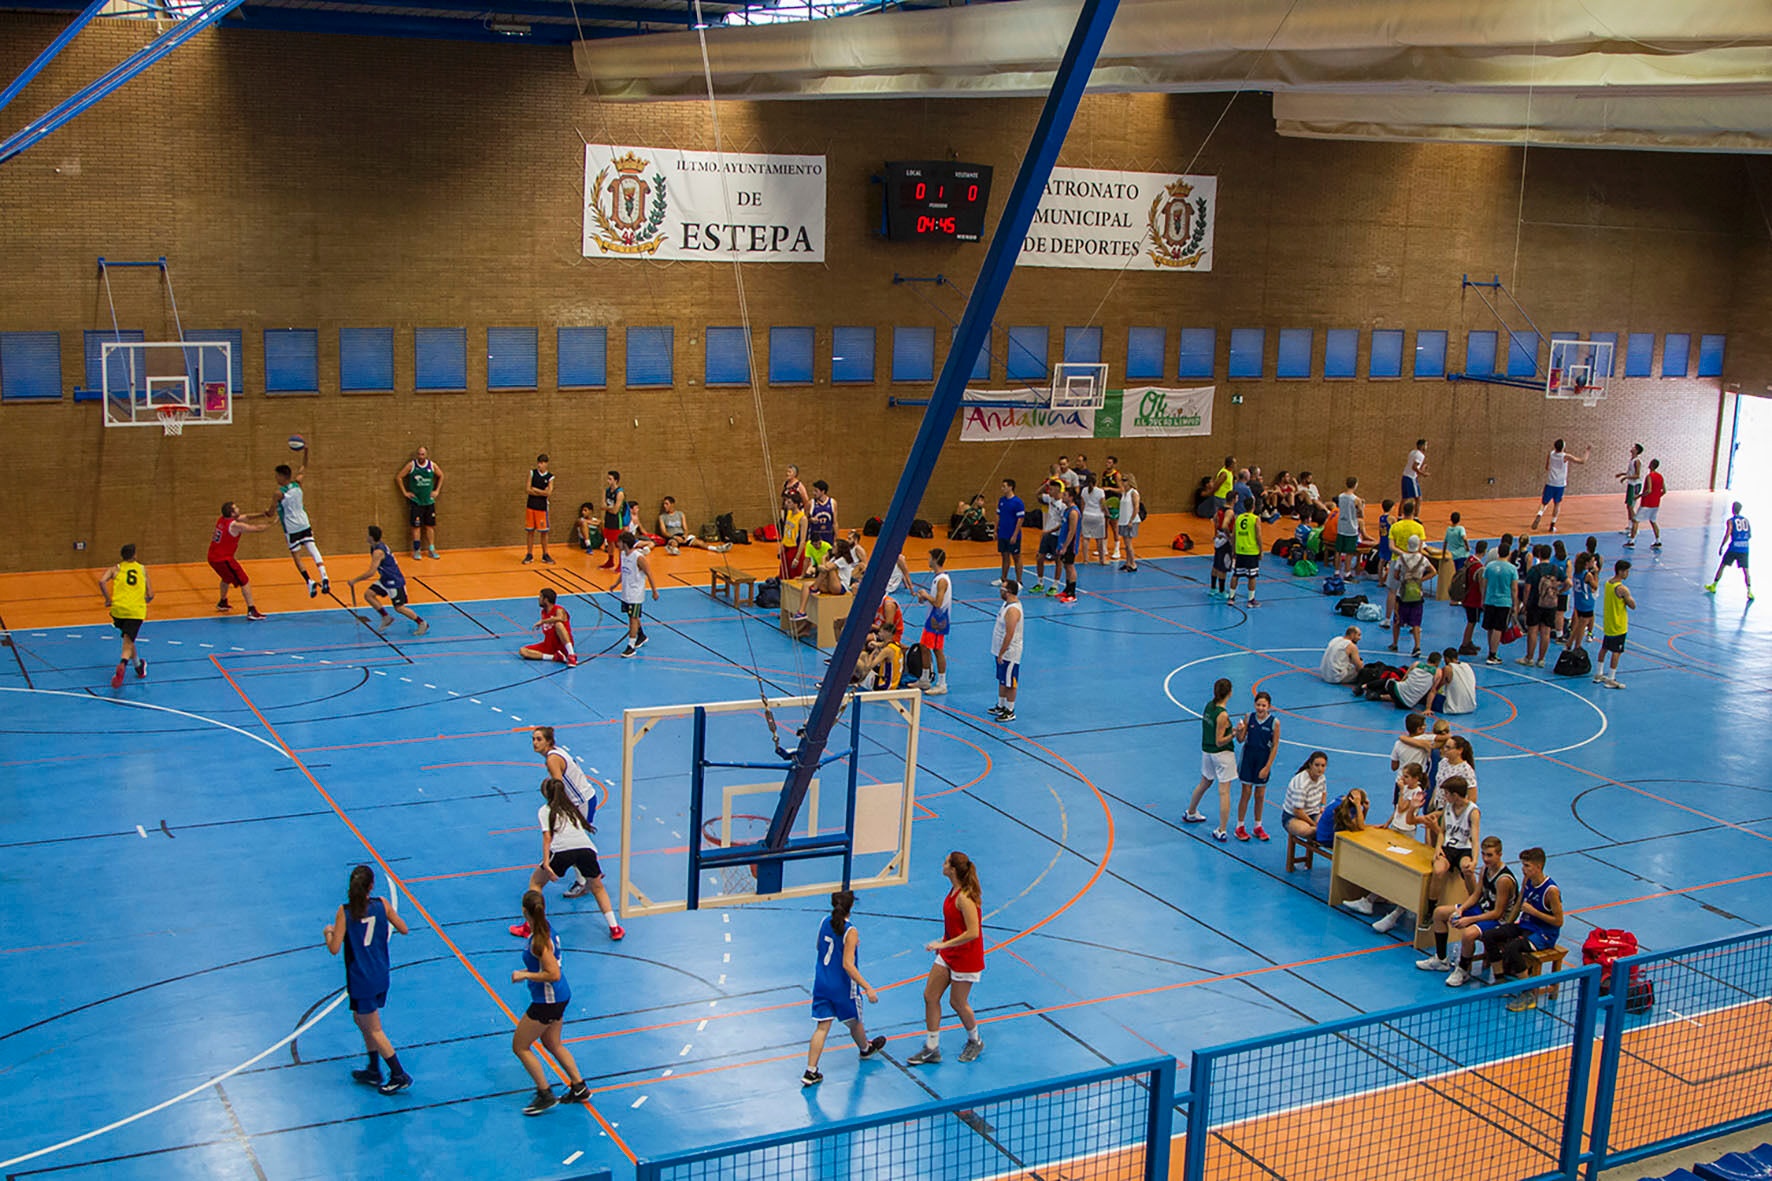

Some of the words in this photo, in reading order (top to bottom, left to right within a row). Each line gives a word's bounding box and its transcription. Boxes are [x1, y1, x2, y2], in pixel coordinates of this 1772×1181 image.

[677, 160, 720, 172] ILTMO.
[722, 163, 822, 175] AYUNTAMIENTO
[906, 169, 922, 177] LOCAL
[737, 191, 762, 206] DE
[915, 182, 926, 200] 0
[939, 185, 944, 198] 1
[967, 184, 979, 202] 0
[1044, 180, 1139, 200] ATRONATO
[917, 215, 956, 234] 04:45
[1033, 208, 1132, 227] MUNICIPAL
[680, 222, 815, 252] ESTEPA
[1023, 236, 1046, 252] DE
[1051, 238, 1140, 257] DEPORTES
[1240, 518, 1248, 530] 6
[1735, 518, 1749, 532] 80
[1369, 549, 1379, 561] 7
[126, 569, 138, 586] 6
[361, 915, 376, 947] 7
[823, 935, 835, 966] 7
